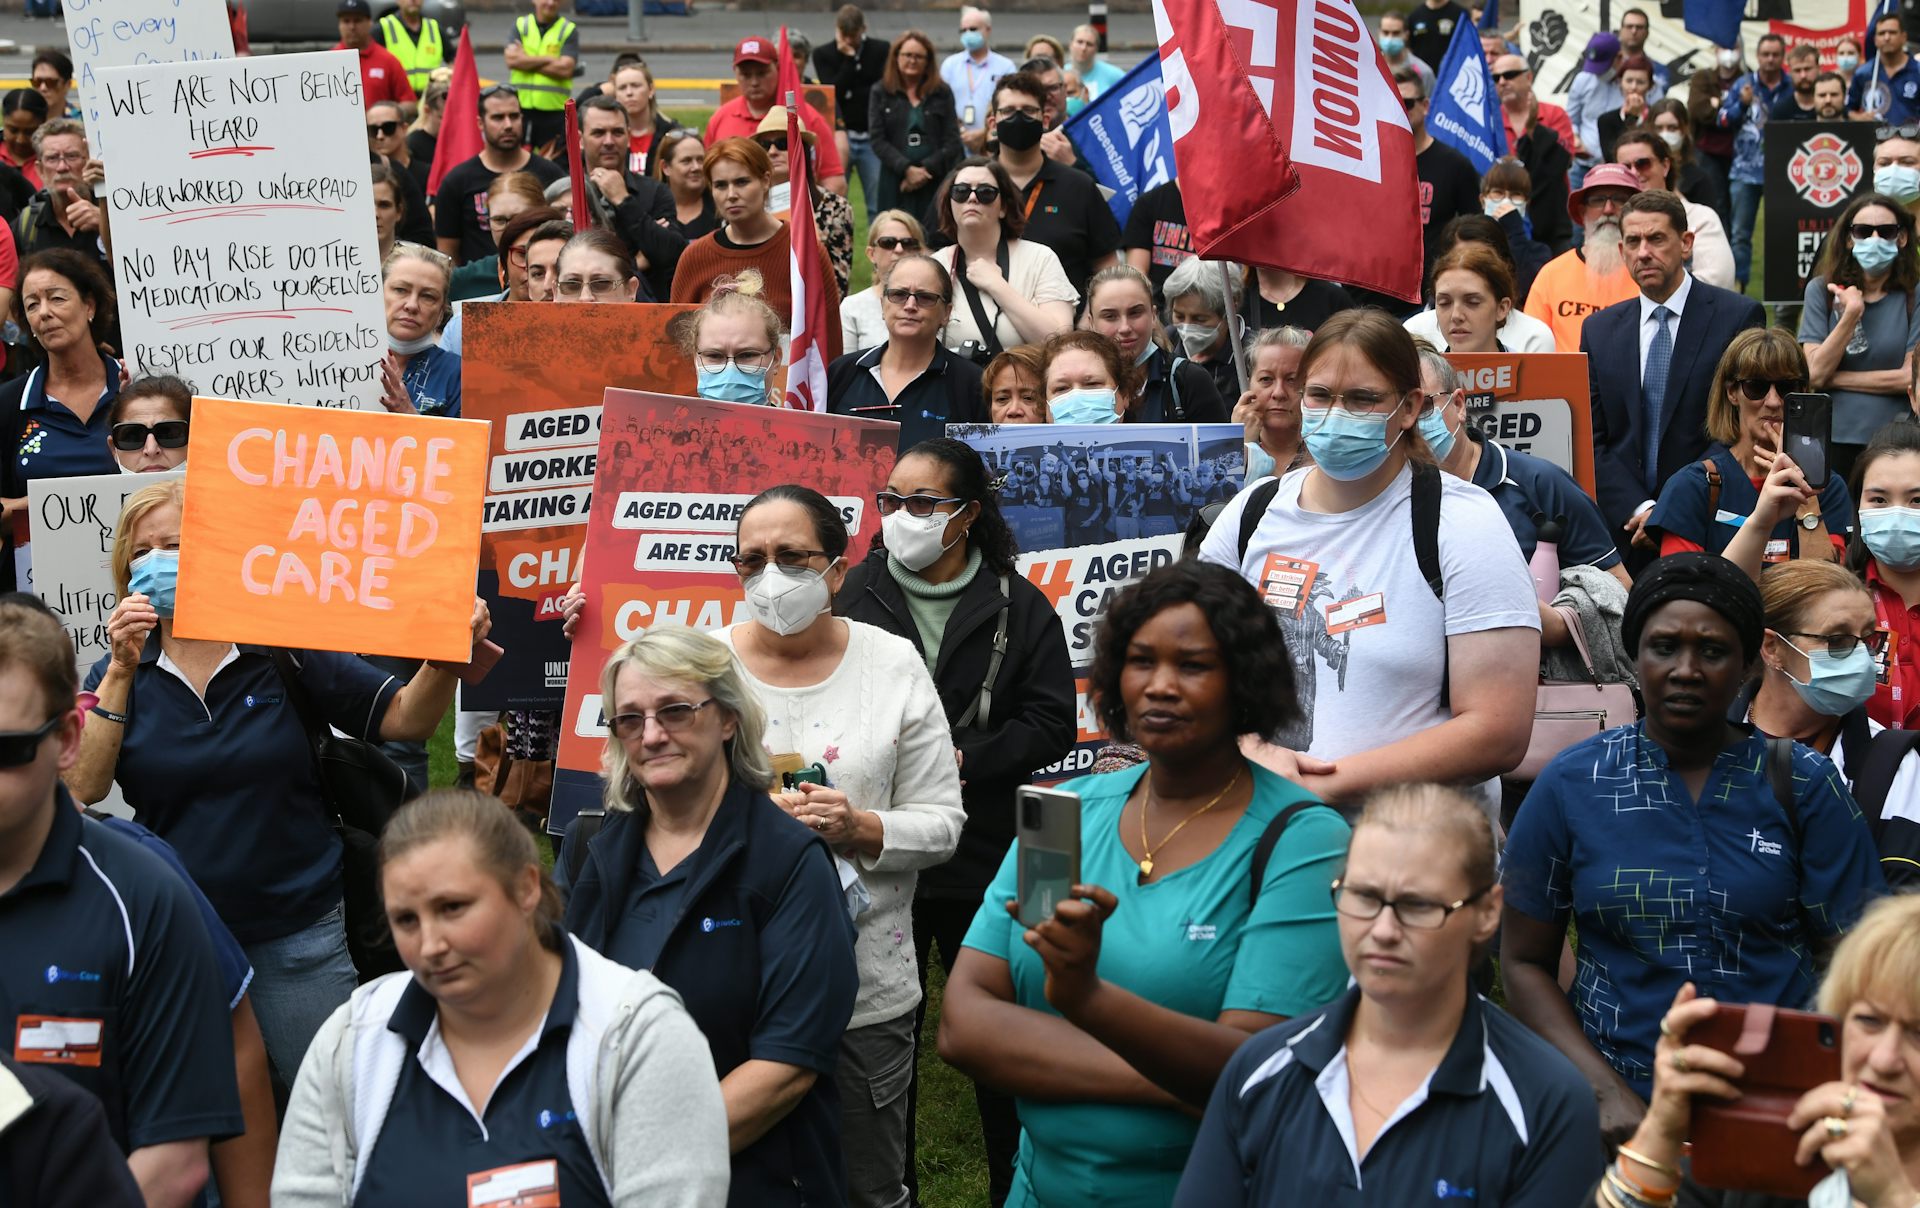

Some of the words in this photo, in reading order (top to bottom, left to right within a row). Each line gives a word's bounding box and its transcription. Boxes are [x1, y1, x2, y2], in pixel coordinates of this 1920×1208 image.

[113, 17, 176, 44] every
[107, 80, 153, 117] WE
[173, 74, 217, 117] ARE
[229, 68, 289, 105] NOT
[300, 66, 362, 105] BEING
[190, 116, 258, 148] HEARD
[1088, 112, 1132, 187] Queensland
[112, 178, 243, 212] OVERWORKED
[258, 172, 358, 205] UNDERPAID
[123, 248, 155, 284] NO
[173, 245, 212, 281] PAY
[228, 241, 275, 273] RISE
[289, 244, 316, 271] DO
[318, 238, 362, 271] THE
[130, 277, 262, 317] MEDICATIONS
[273, 270, 379, 311] YOURSELVES
[135, 337, 222, 375] RESPECT
[230, 336, 274, 360] OUR
[282, 323, 379, 360] RESIDENTS
[212, 369, 284, 399] CARERS
[297, 360, 382, 393] WITHOUT
[519, 414, 590, 440] AGED
[226, 427, 457, 504] CHANGE
[42, 493, 106, 531] OUR
[287, 498, 439, 557] AGED
[483, 494, 576, 523] TAKING
[624, 501, 683, 519] AGED
[687, 502, 742, 522] CARE
[647, 542, 692, 561] ARE
[1082, 548, 1173, 585] AGED
[240, 545, 395, 610] CARE
[59, 622, 111, 654] HERE
